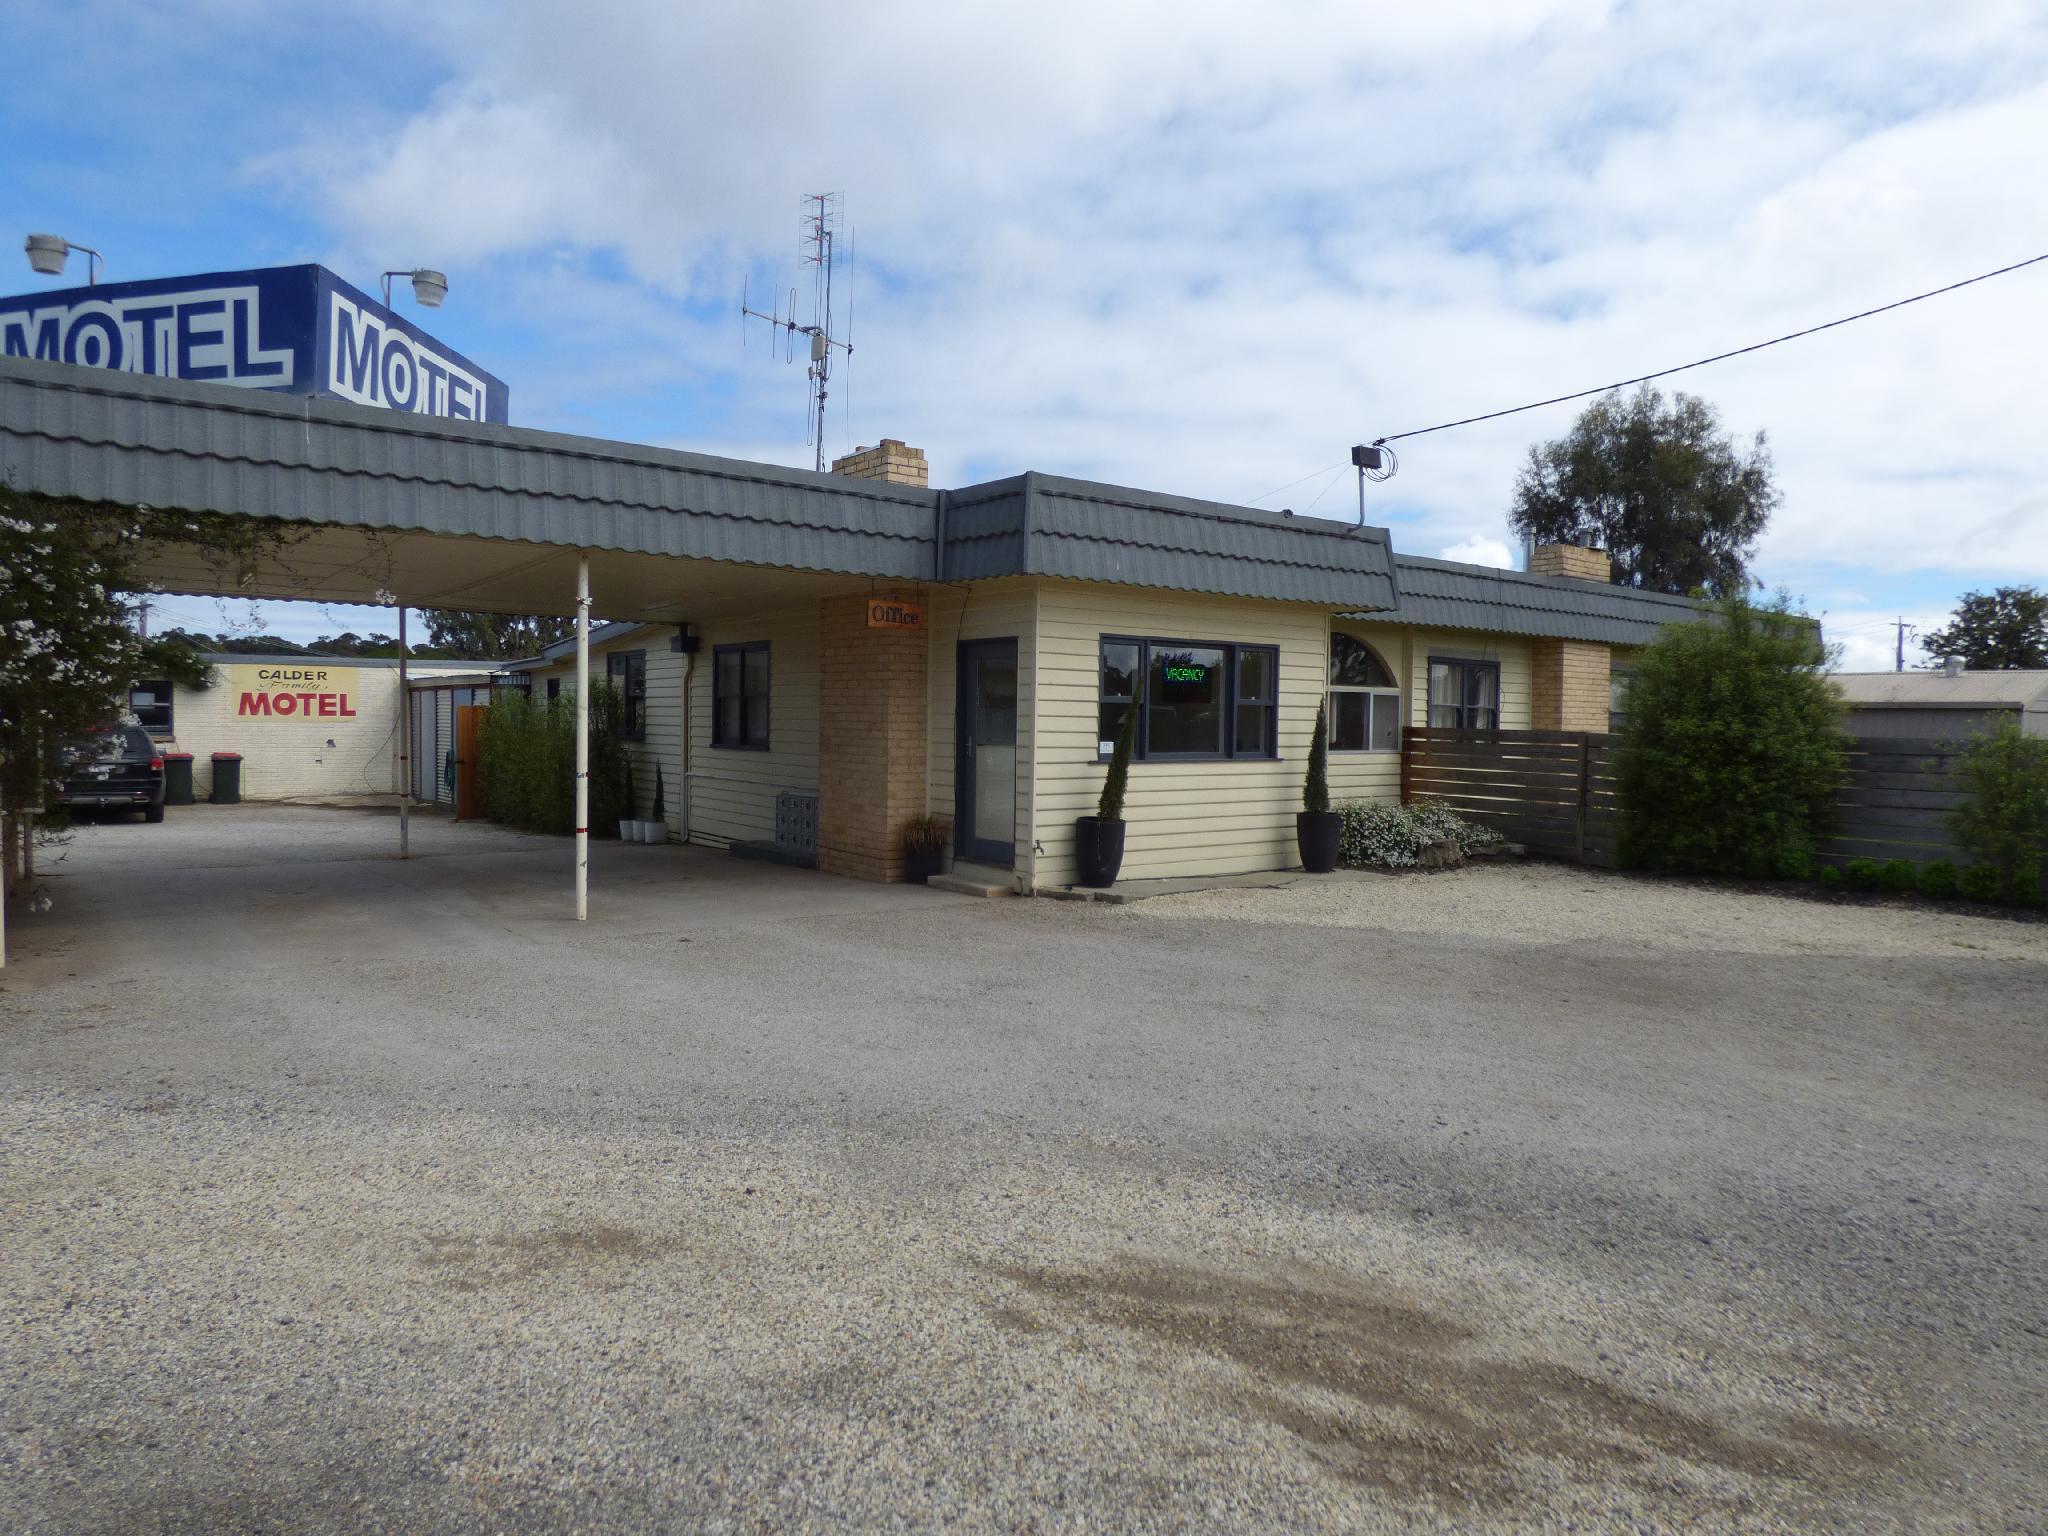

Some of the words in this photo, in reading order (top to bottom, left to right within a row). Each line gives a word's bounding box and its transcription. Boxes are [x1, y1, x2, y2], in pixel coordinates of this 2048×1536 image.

[0, 288, 292, 386] MOTEL
[871, 604, 919, 625] Office
[258, 669, 328, 681] CALDER
[270, 680, 321, 692] Family
[238, 692, 357, 717] MOTEL
